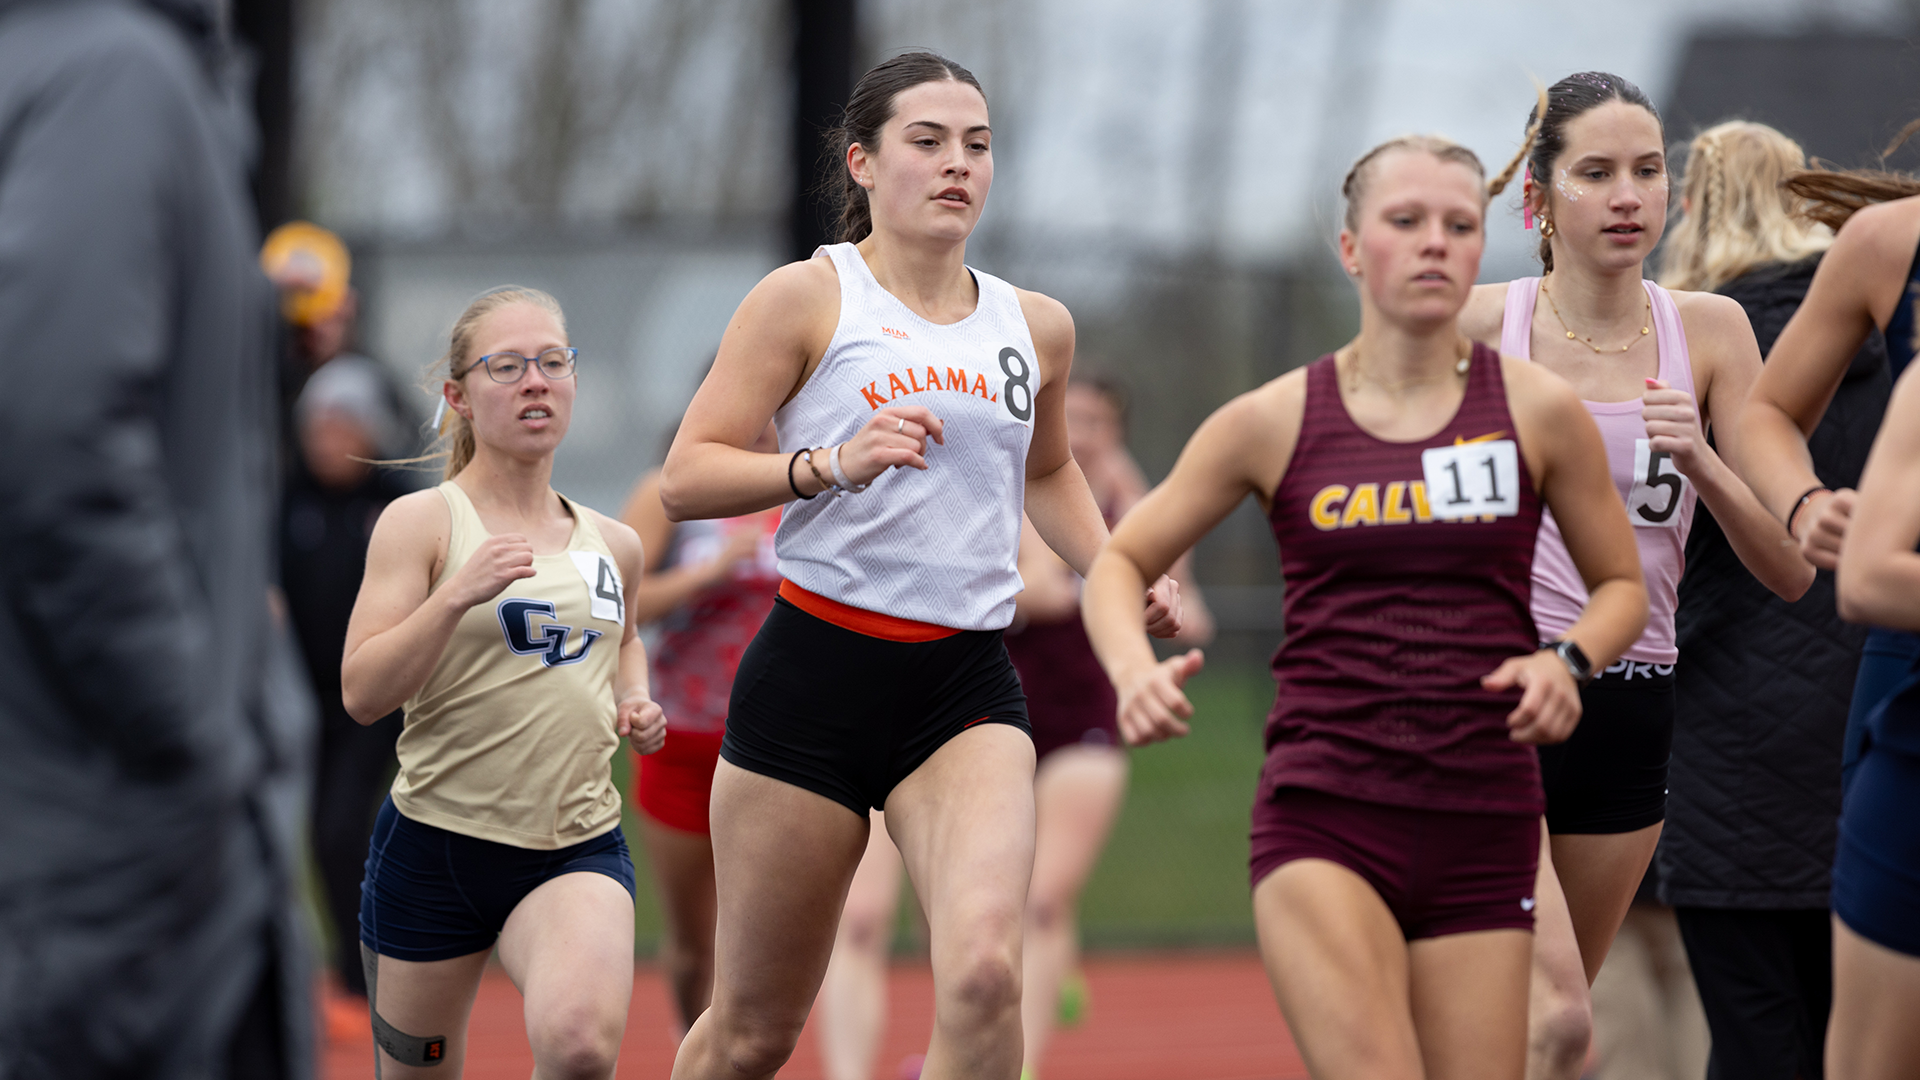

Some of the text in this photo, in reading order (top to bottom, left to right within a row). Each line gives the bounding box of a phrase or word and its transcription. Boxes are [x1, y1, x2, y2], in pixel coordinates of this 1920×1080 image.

[860, 366, 997, 411] KALAMA
[999, 347, 1031, 421] 8
[1309, 479, 1497, 531] CALV
[1443, 454, 1505, 505] 11
[1637, 451, 1681, 522] 5
[595, 556, 622, 620] 4
